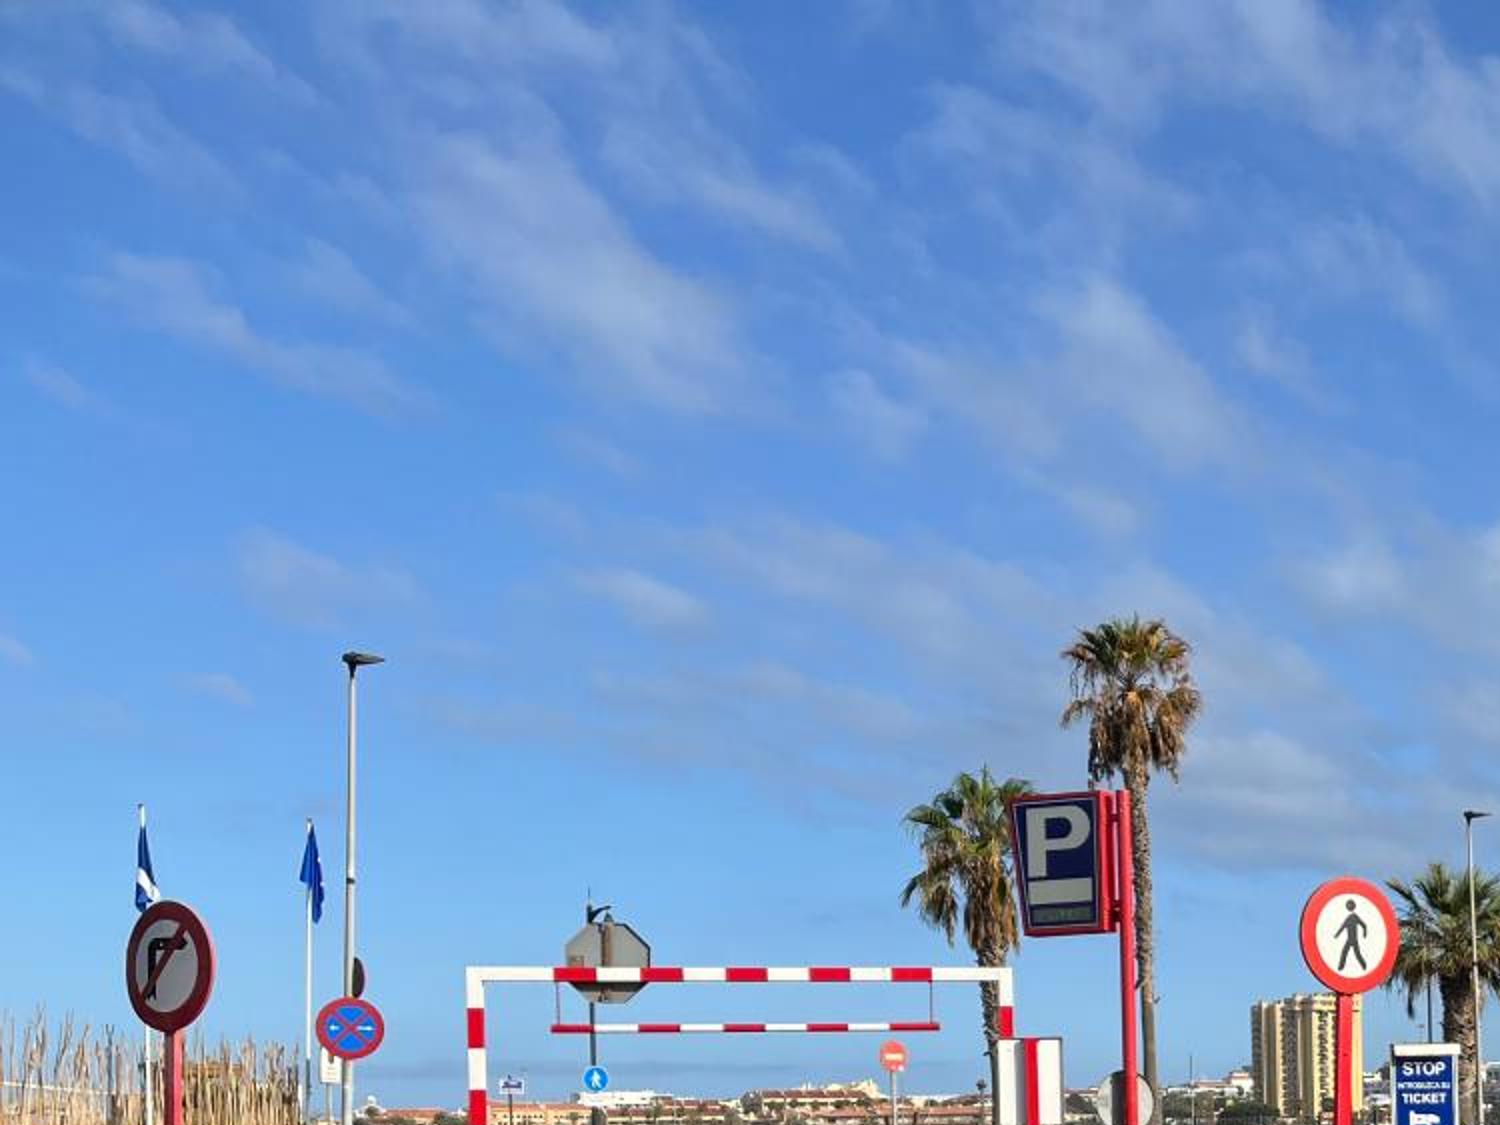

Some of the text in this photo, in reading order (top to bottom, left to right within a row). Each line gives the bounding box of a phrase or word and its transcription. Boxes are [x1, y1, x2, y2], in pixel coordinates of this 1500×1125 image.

[1026, 805, 1091, 878] P
[1402, 1061, 1446, 1076] STOP
[1402, 1092, 1447, 1105] TICKET
